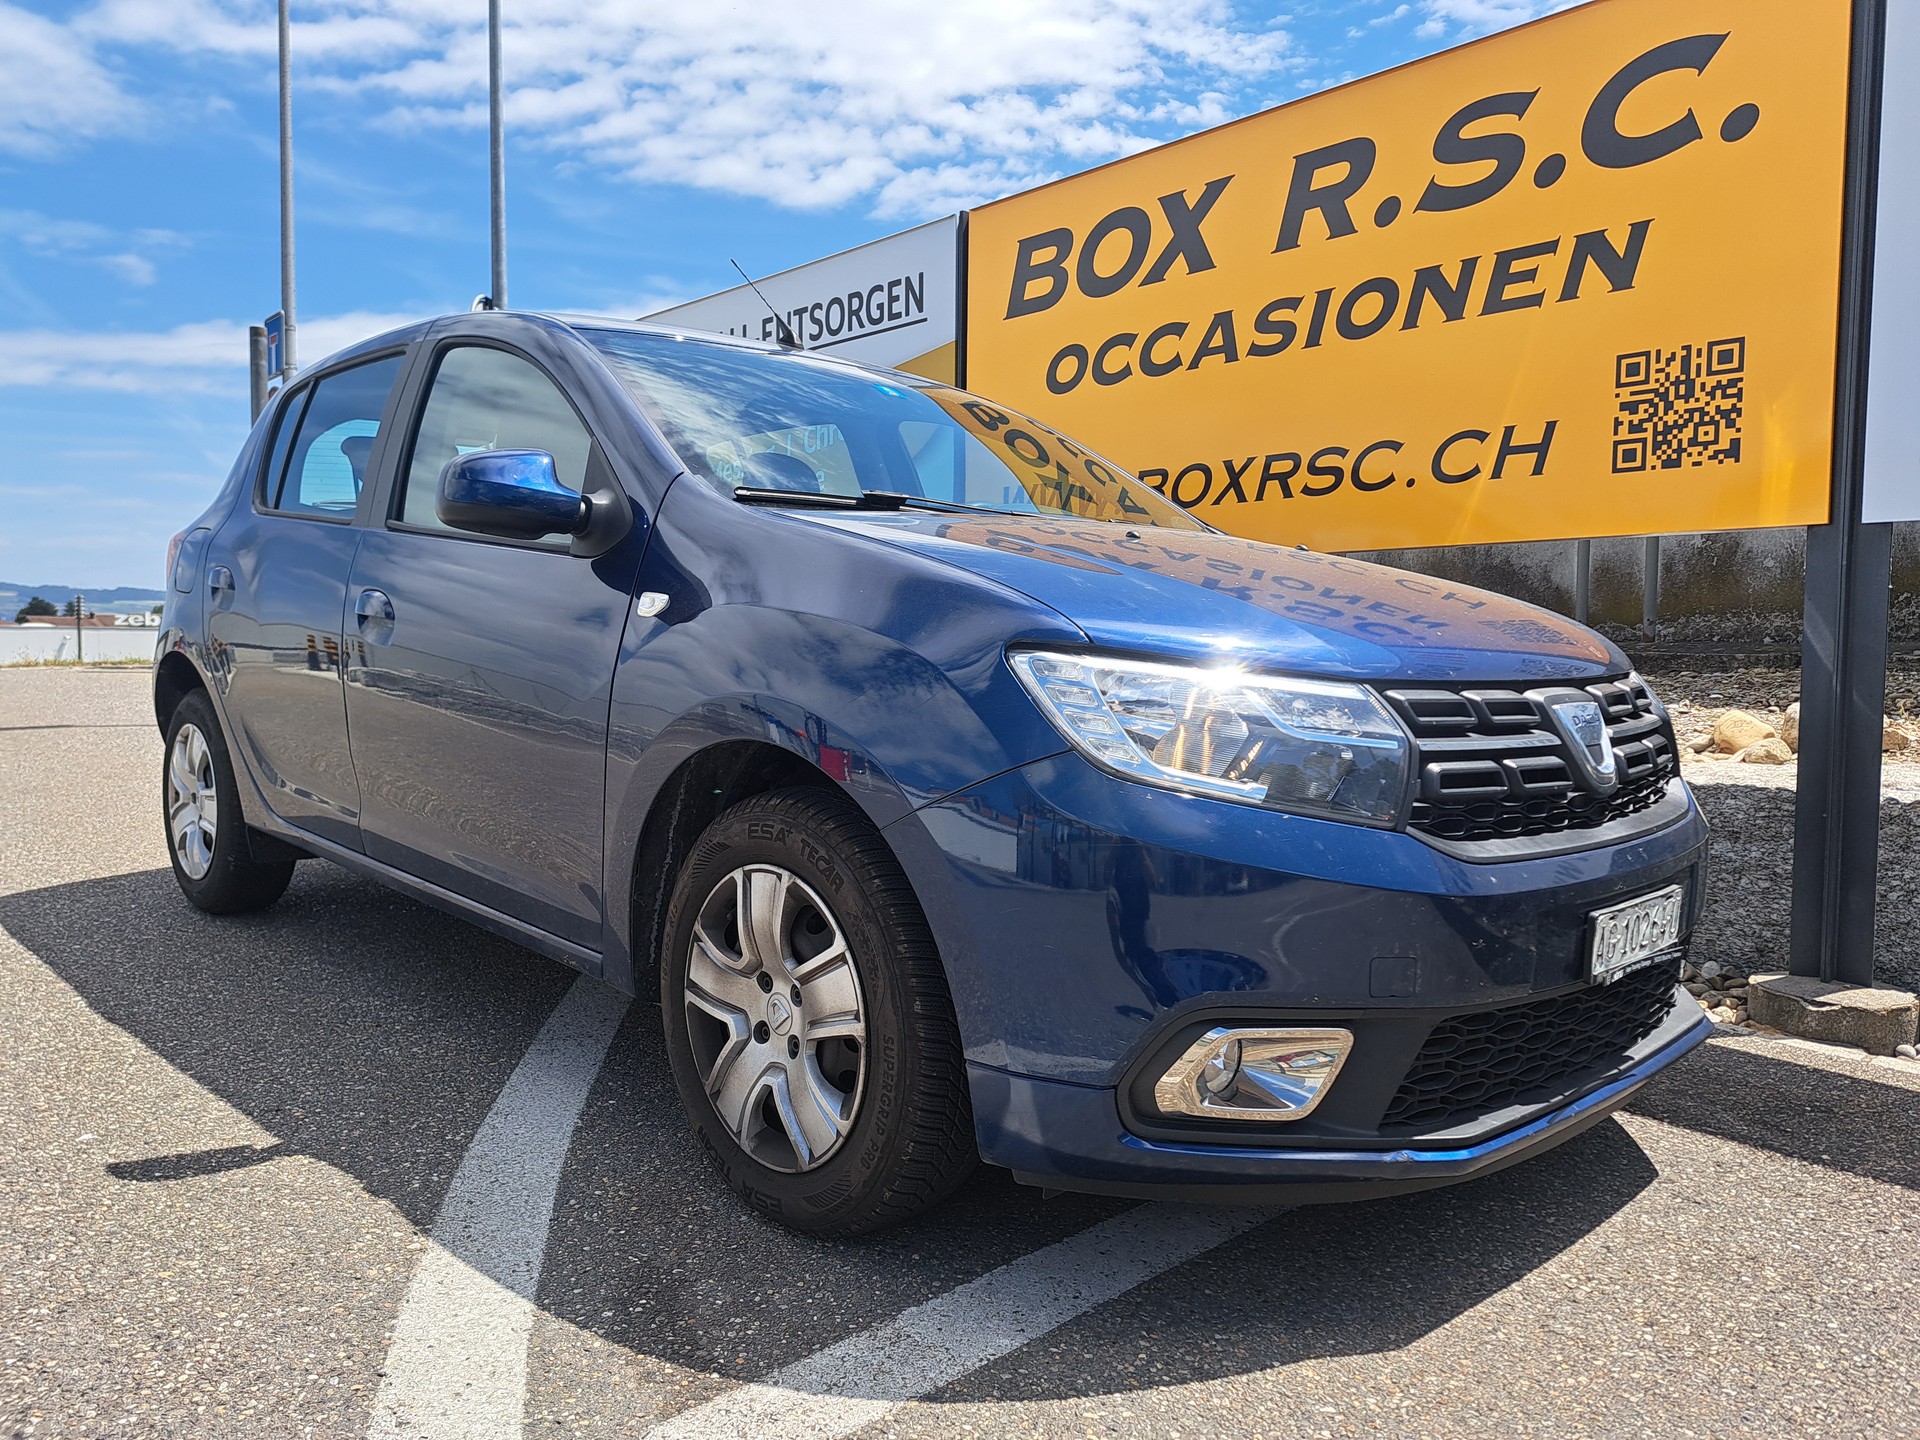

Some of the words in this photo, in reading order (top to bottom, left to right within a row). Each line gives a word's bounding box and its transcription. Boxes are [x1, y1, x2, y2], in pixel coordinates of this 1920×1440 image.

[1003, 174, 1235, 321] BOX
[1271, 31, 1760, 254] R.S.C.
[1045, 218, 1656, 395] OCCASIONEN
[114, 611, 162, 626] zeb
[800, 837, 845, 895] TECAR
[875, 1034, 895, 1137] SUPERGRIP
[861, 1140, 880, 1170] PRO
